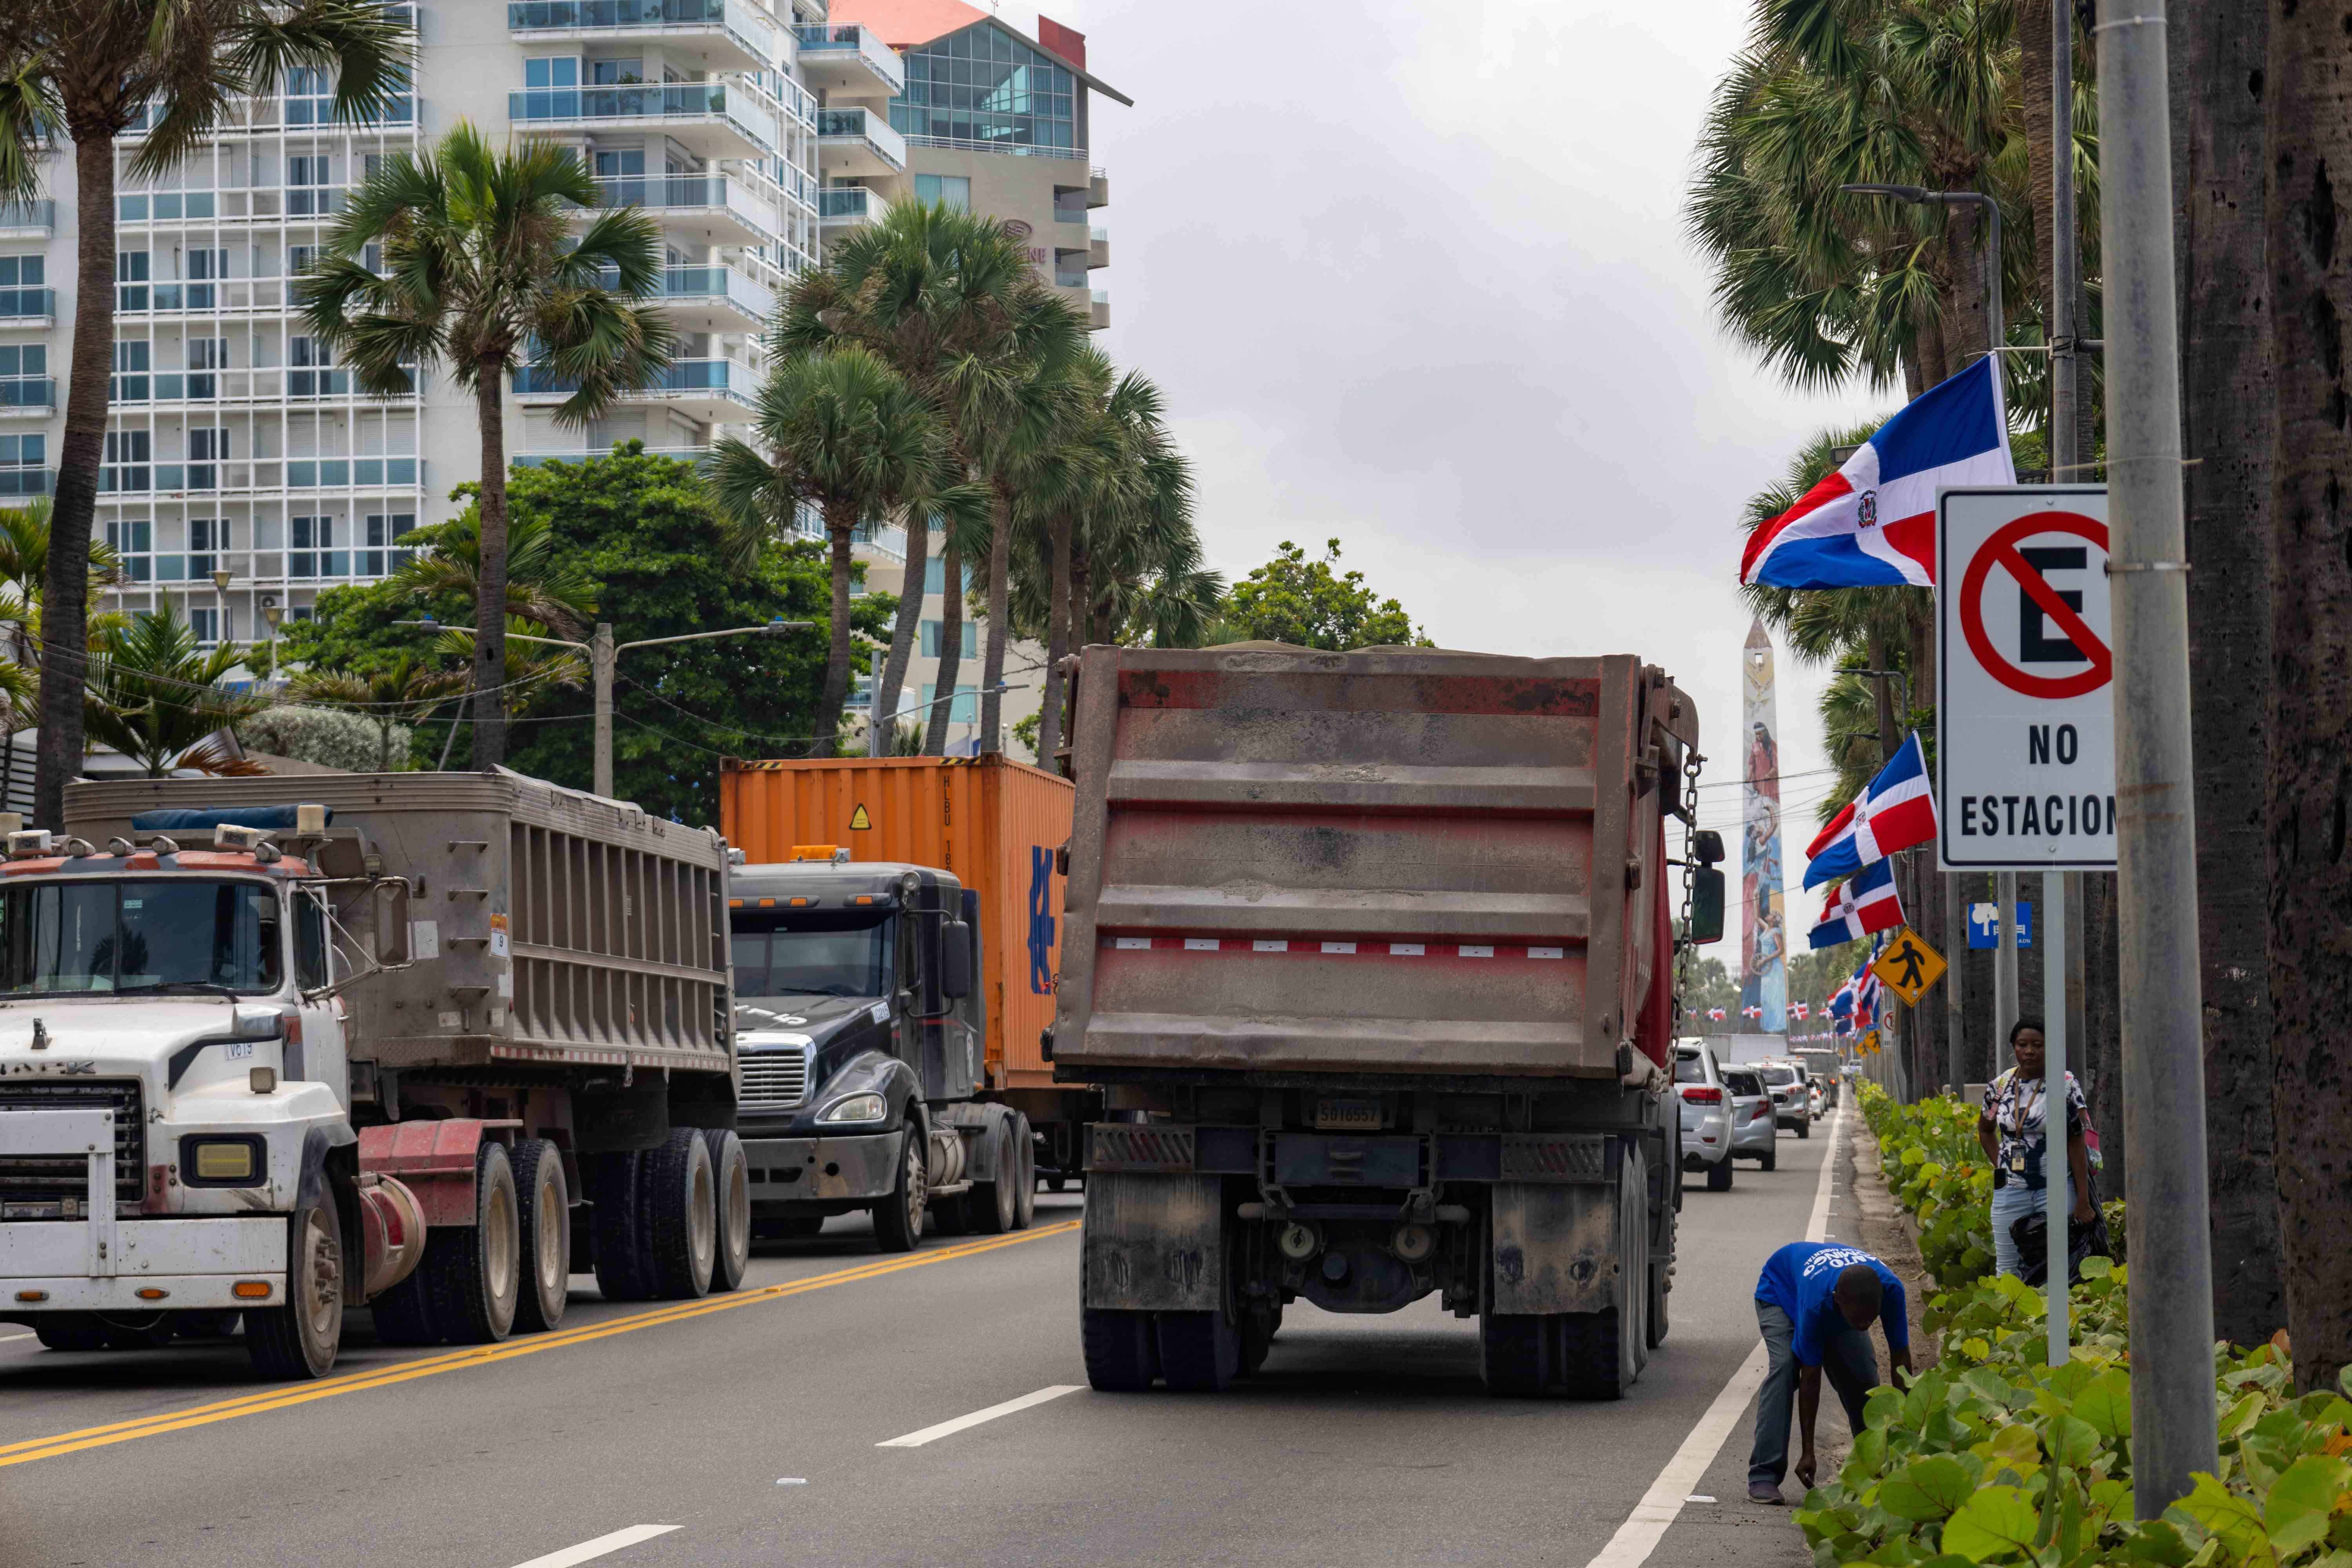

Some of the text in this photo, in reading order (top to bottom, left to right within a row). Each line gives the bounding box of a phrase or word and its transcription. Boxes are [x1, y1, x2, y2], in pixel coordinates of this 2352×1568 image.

[2029, 724, 2078, 765] NO
[499, 935, 503, 947] 9
[1804, 1248, 1838, 1266] AMBIENTAL
